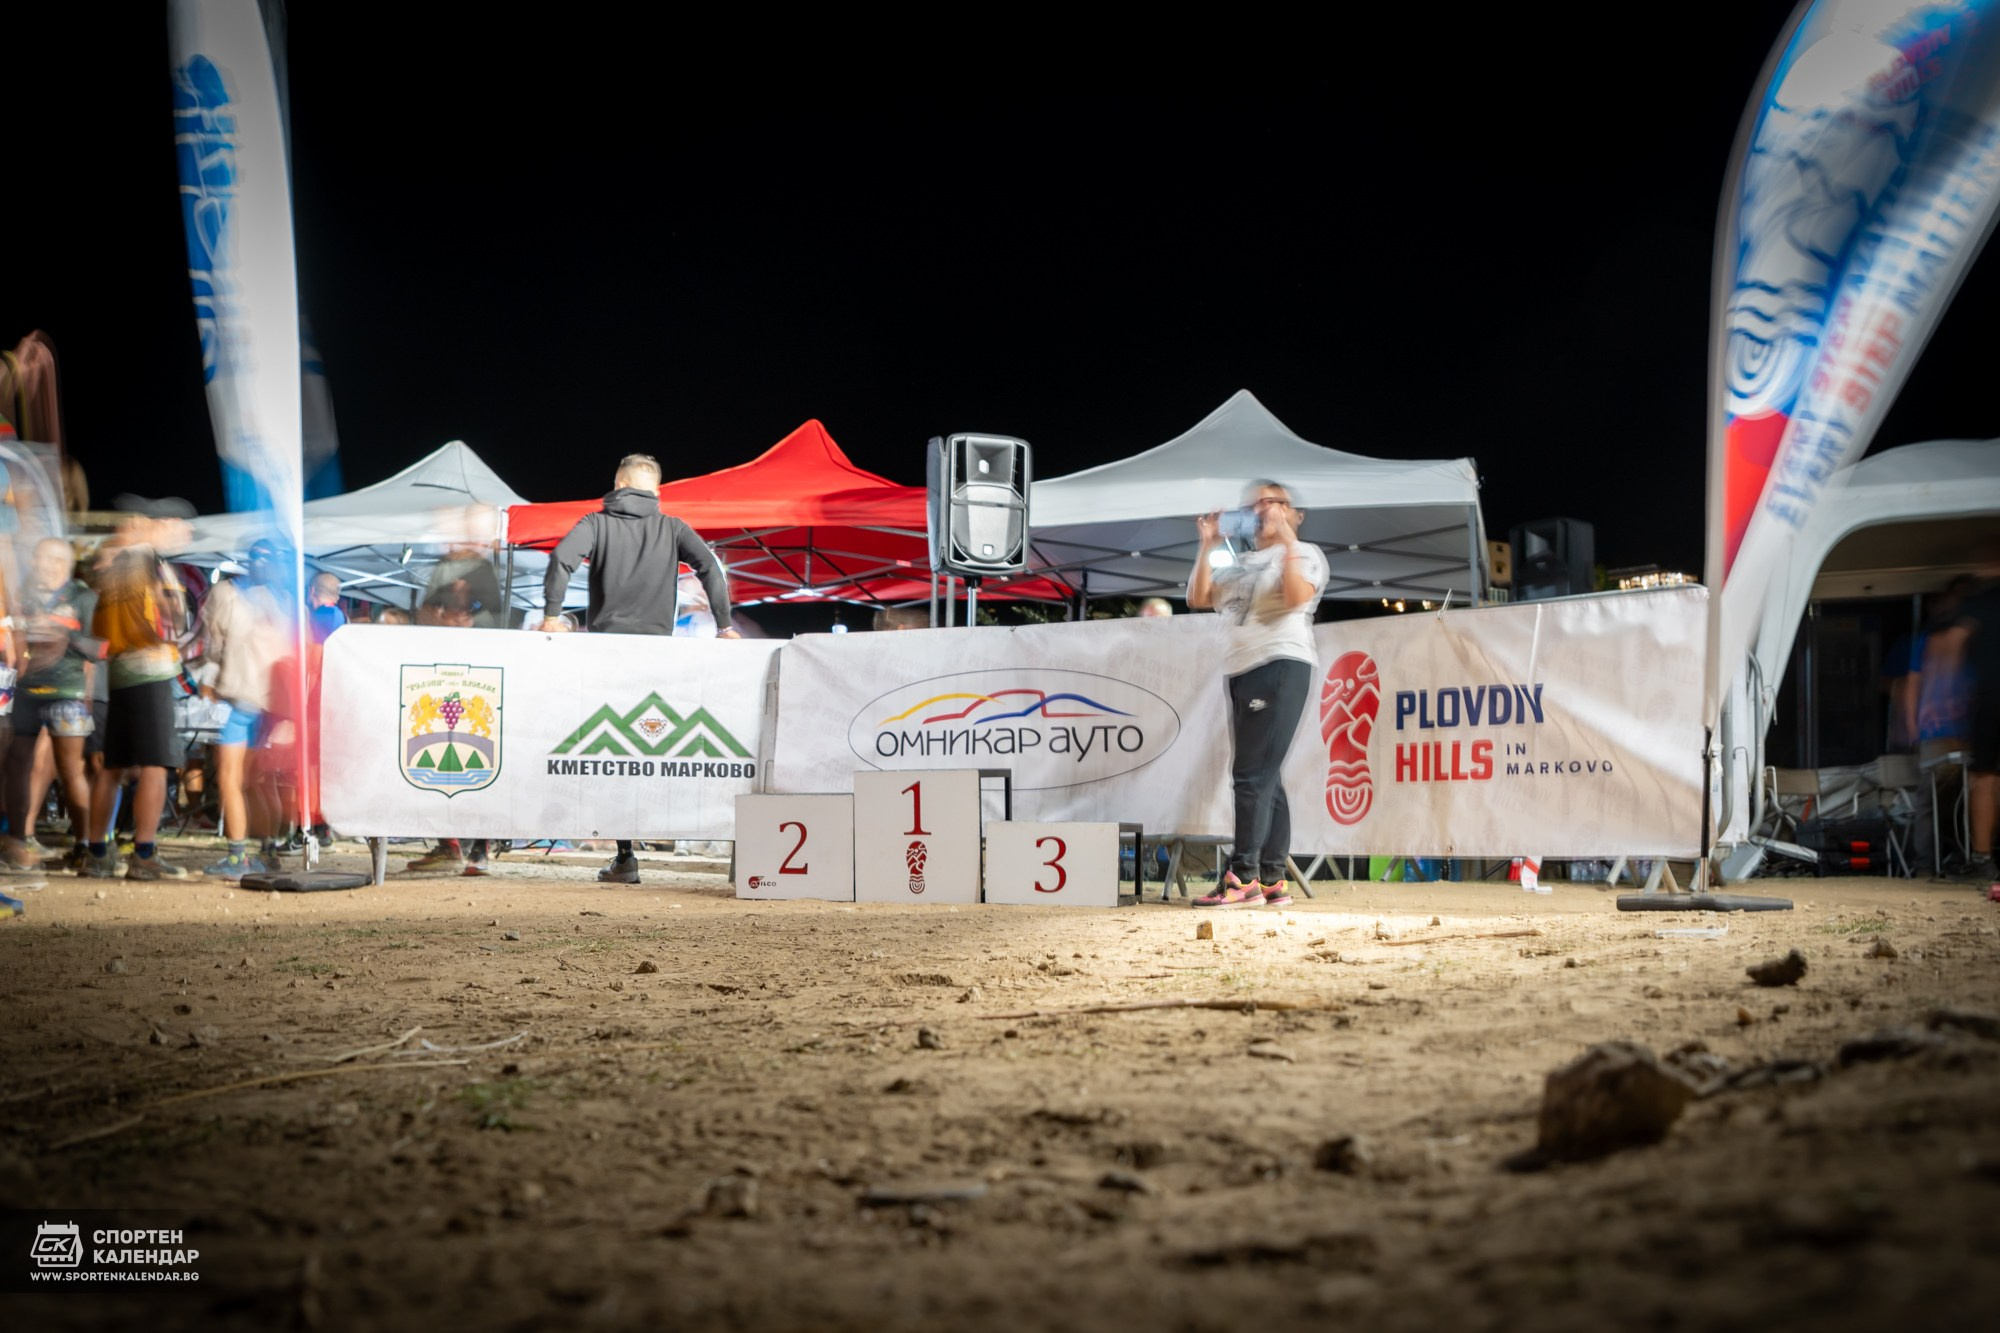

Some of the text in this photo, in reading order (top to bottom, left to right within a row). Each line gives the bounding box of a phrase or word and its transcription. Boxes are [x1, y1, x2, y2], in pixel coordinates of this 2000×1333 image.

[547, 759, 655, 777] КМЕТСТВО
[660, 759, 756, 779] МАРКОВО
[1396, 739, 1494, 783] HILLS
[1506, 760, 1613, 776] MARKOVO
[1507, 743, 1526, 756] IN
[901, 780, 931, 836] 1
[779, 821, 809, 875] 2
[1034, 836, 1067, 894] 3
